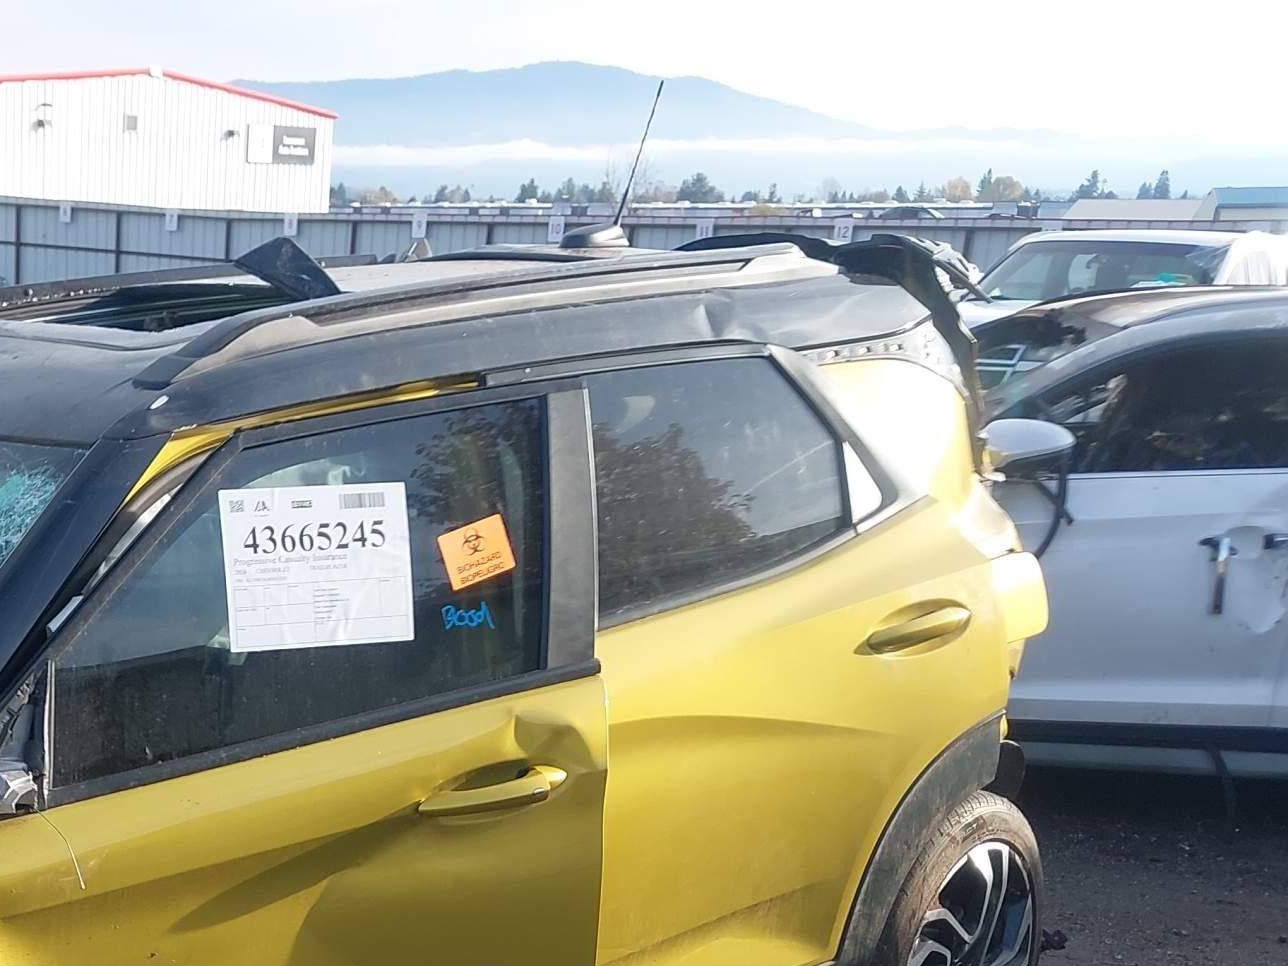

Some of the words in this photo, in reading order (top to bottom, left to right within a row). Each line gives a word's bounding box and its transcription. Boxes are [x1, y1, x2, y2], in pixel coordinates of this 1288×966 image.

[550, 223, 562, 235] 10
[836, 225, 850, 239] 12
[243, 519, 386, 555] 43665245
